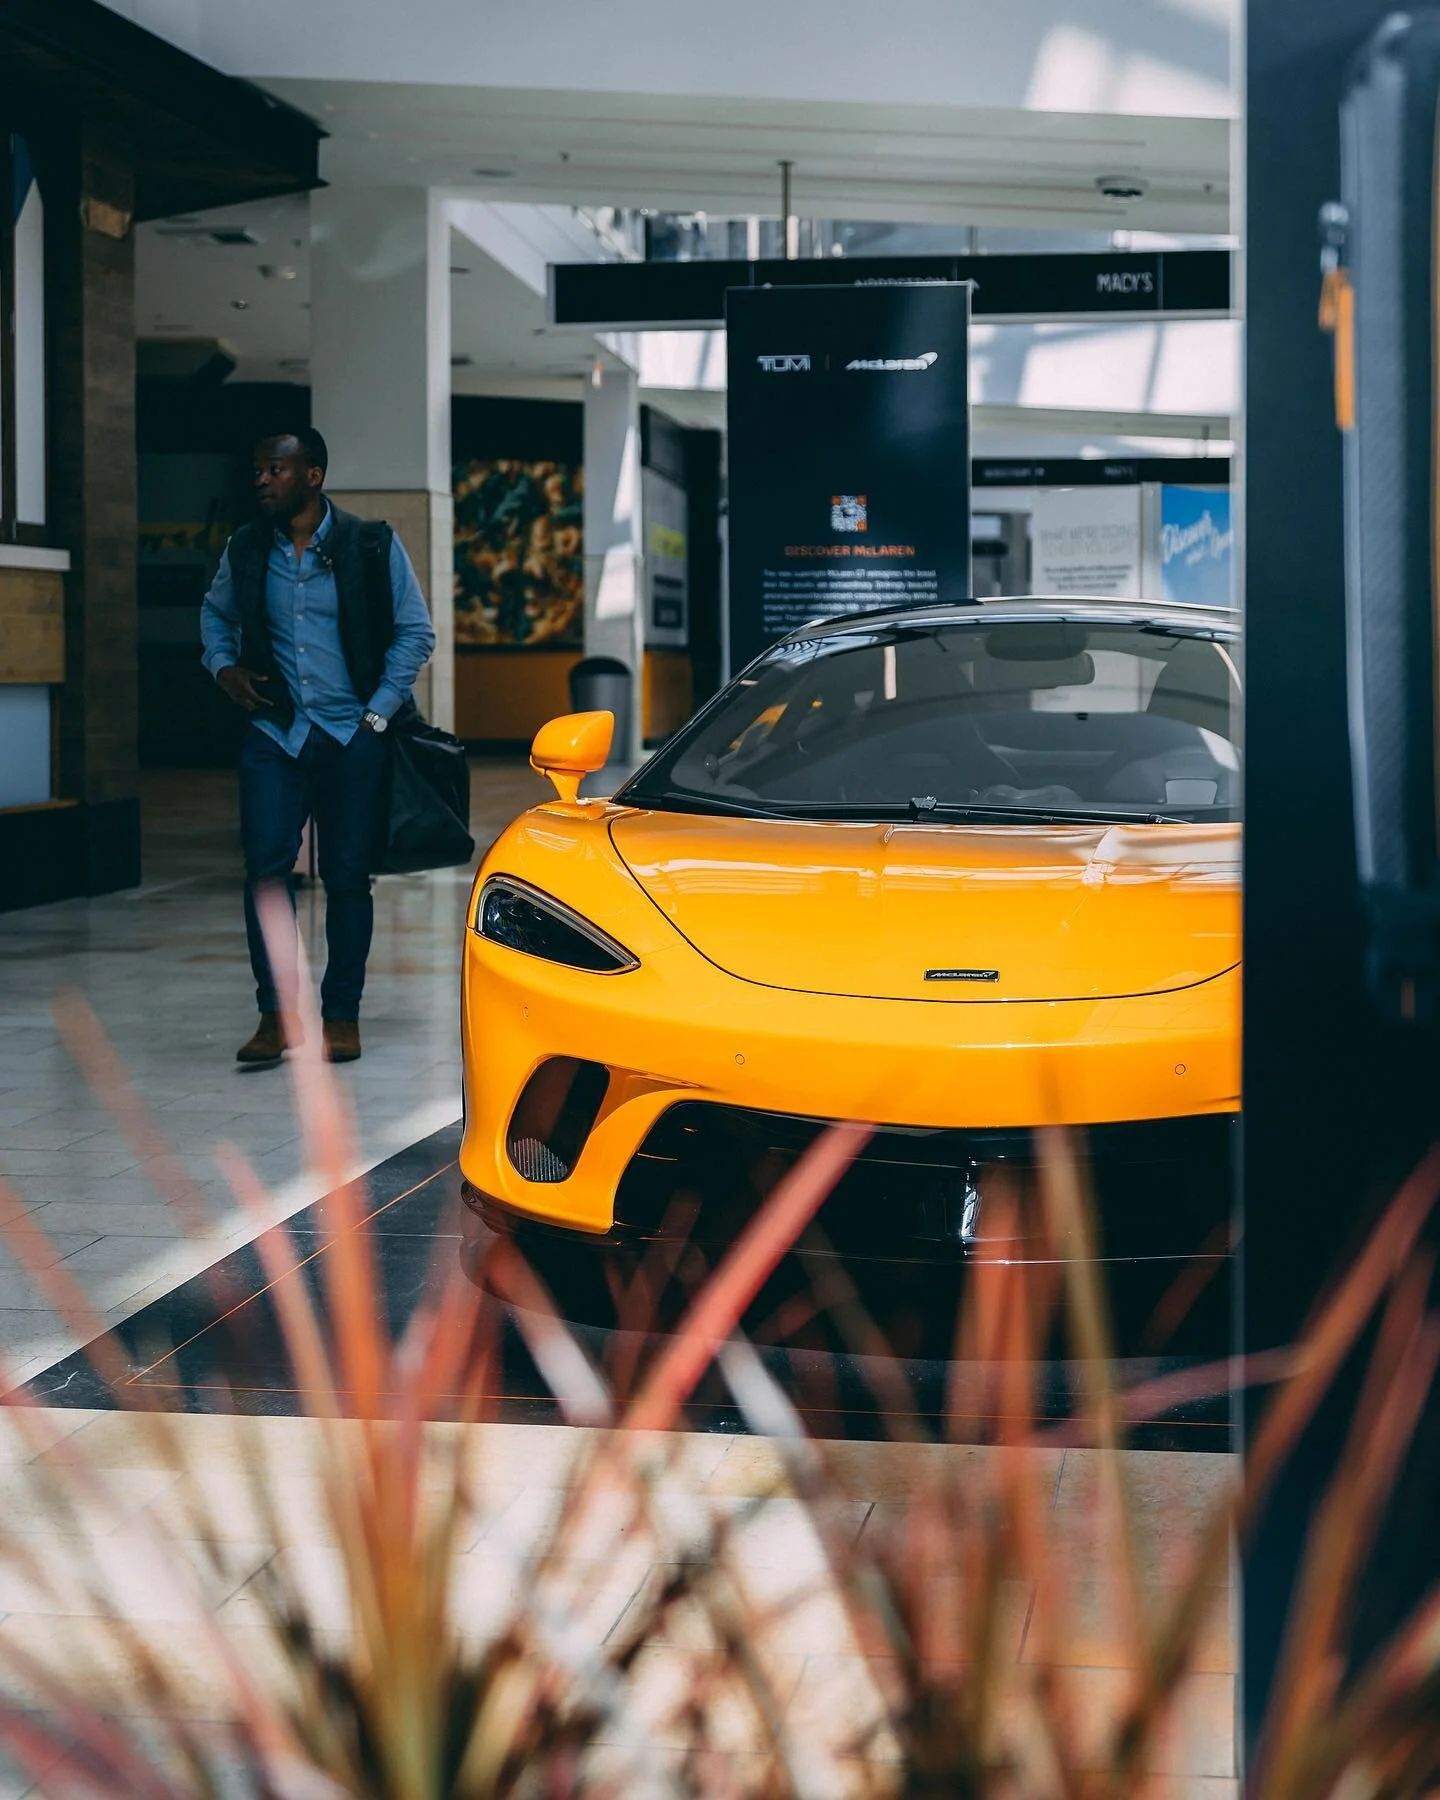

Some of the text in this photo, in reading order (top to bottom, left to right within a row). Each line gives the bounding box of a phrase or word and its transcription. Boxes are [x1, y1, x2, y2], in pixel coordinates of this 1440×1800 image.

[1096, 272, 1153, 293] MACY'S
[757, 354, 811, 373] TUMI
[784, 545, 850, 557] DISCOVER
